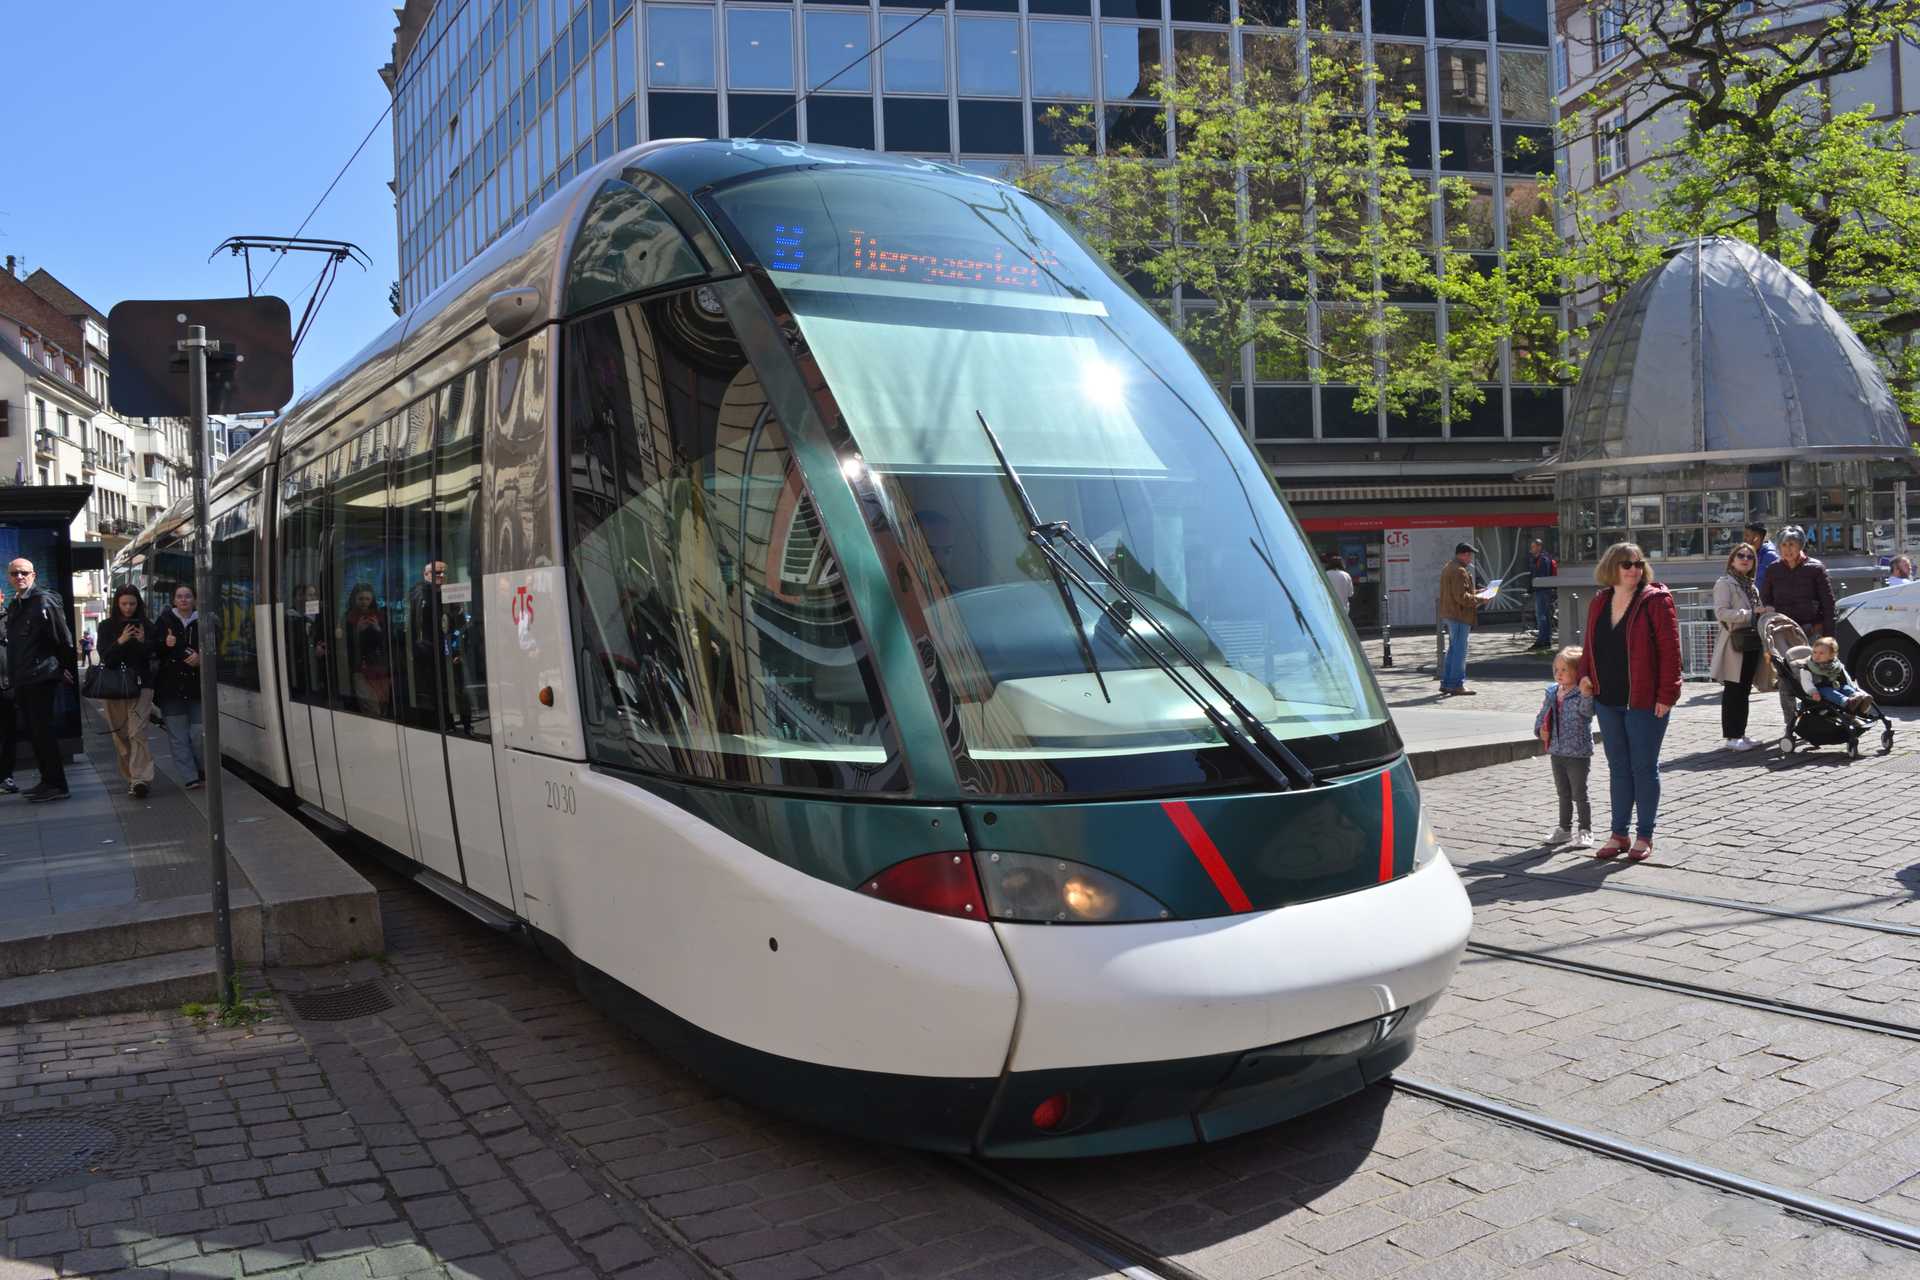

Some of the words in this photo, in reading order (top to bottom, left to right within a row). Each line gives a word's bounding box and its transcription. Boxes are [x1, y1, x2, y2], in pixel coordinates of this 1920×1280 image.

[1386, 530, 1409, 545] CTS
[512, 586, 534, 625] CTS
[545, 781, 577, 816] 2030
